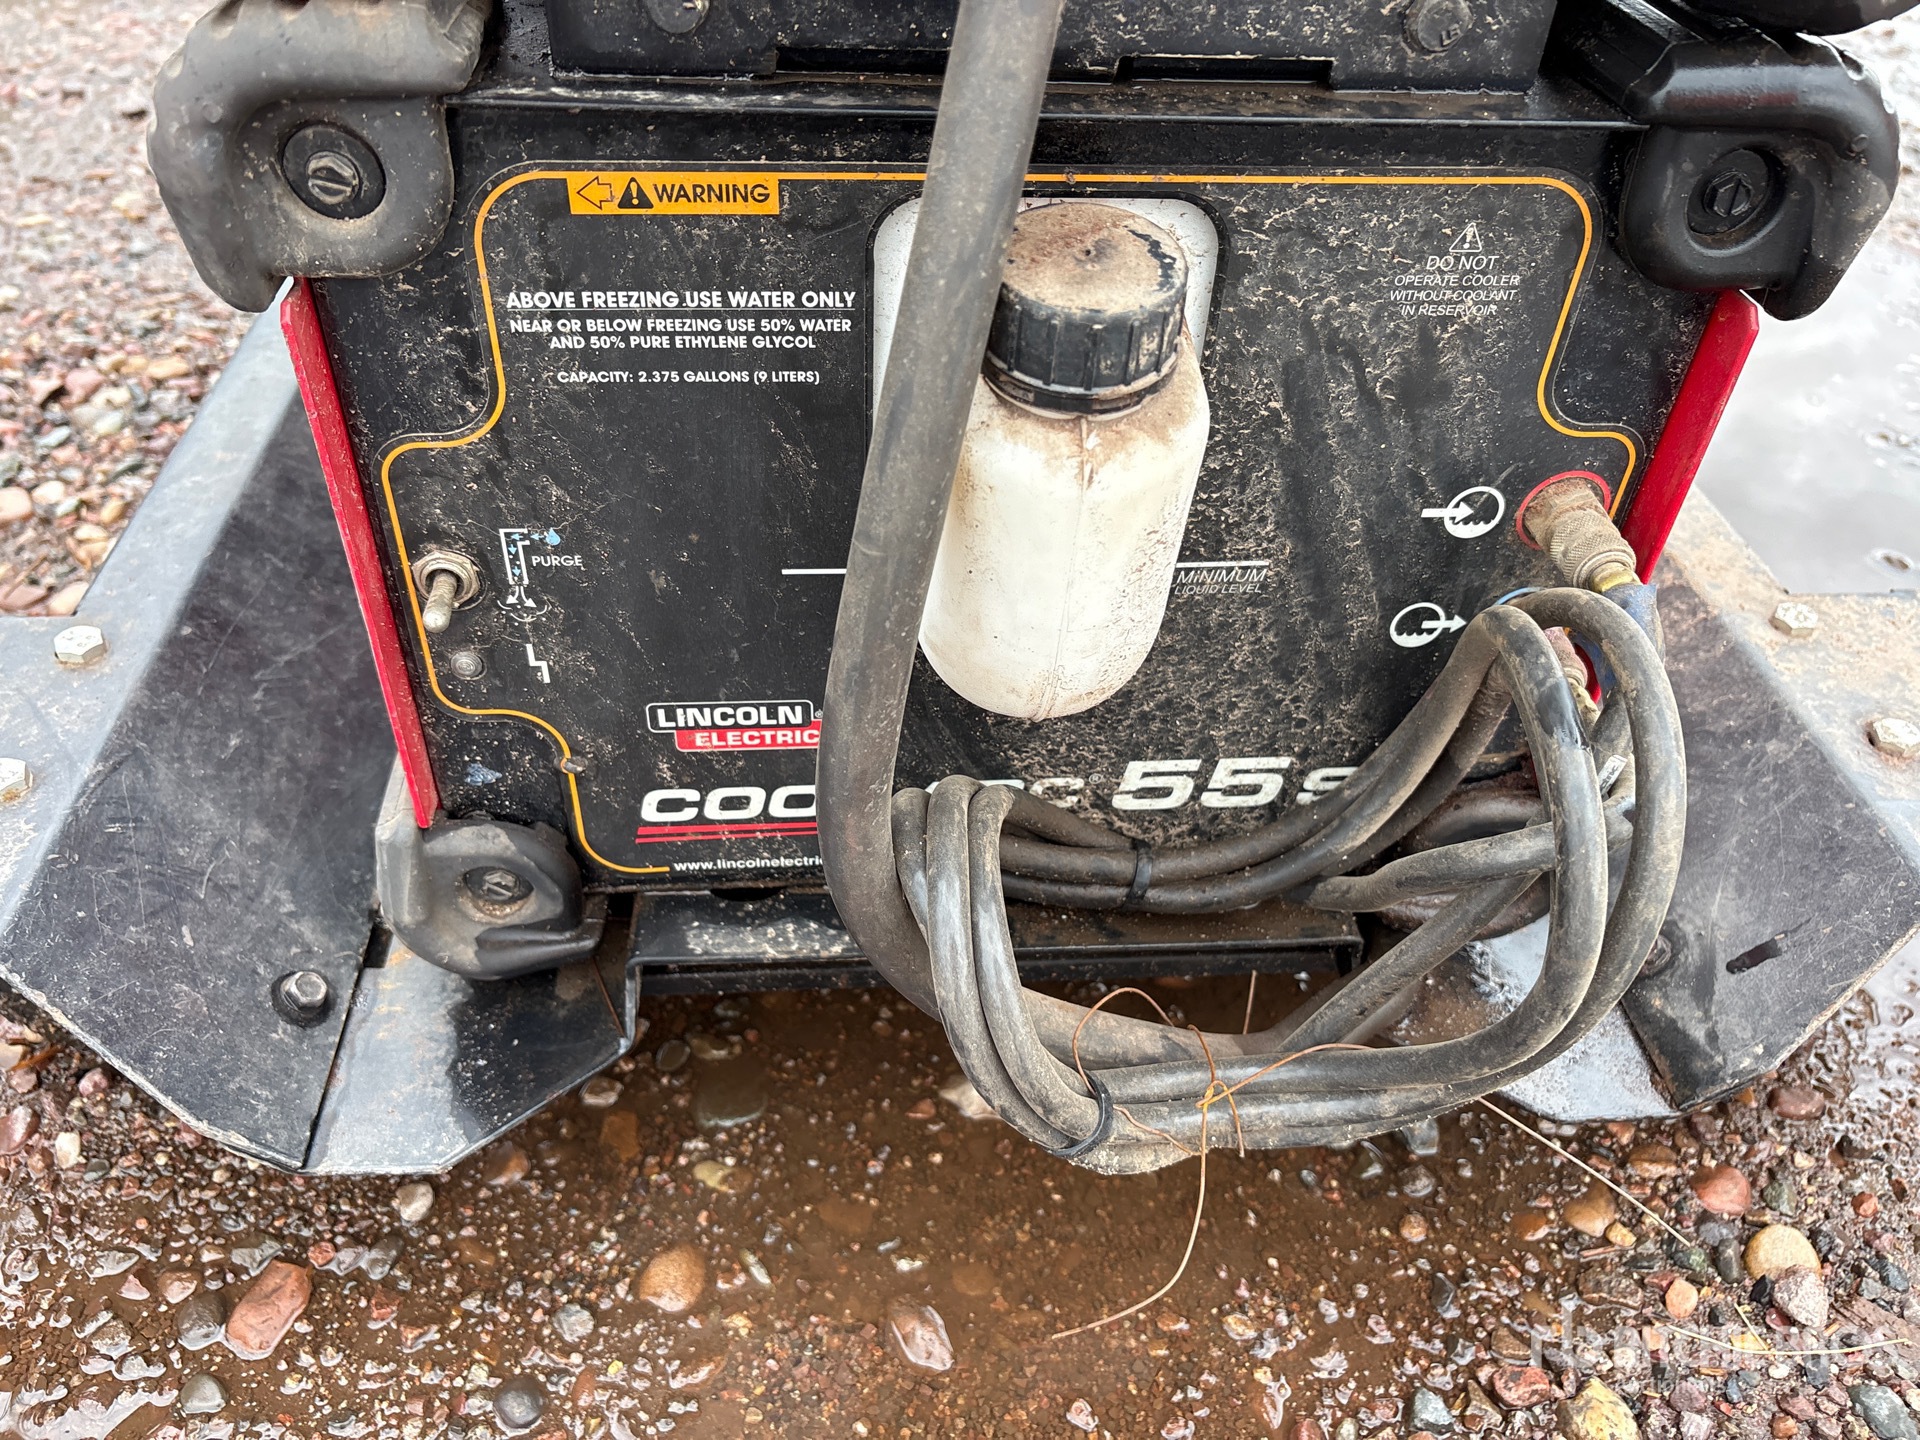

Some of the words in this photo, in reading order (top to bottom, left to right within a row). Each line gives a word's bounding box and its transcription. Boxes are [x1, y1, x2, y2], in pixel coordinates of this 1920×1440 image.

[653, 183, 771, 204] WARNING
[1426, 255, 1455, 270] DO
[1458, 255, 1500, 270] NOT
[1394, 275, 1460, 286] OPERATE
[1462, 275, 1521, 286] COOLER
[506, 291, 575, 308] ABOVE
[581, 290, 678, 308] FREEZING
[728, 291, 795, 308] WATER
[801, 291, 856, 308] ONLY
[1390, 290, 1450, 301] WITHOUT
[1452, 290, 1518, 301] COOLANT
[1400, 305, 1416, 316] IN
[1418, 304, 1498, 316] RESERVOIR
[510, 318, 552, 333] NEAR
[556, 318, 582, 332] OR
[586, 318, 642, 332] BELOW
[647, 318, 722, 332] FREEZING
[727, 318, 756, 332] USE
[760, 318, 796, 332] 50%
[800, 318, 852, 332] WATER
[550, 335, 585, 349] AND
[590, 335, 625, 349] 50%
[630, 335, 671, 348] PURE
[675, 335, 748, 348] ETHYLENE
[752, 335, 816, 349] GLYCOL
[557, 370, 634, 384] CAPACITY:
[638, 370, 680, 383] 2.375
[683, 370, 750, 383] GALLONS
[753, 370, 770, 386] (9
[772, 370, 820, 385] LITERS)
[531, 555, 583, 567] PURGE
[1176, 568, 1268, 583] MINIMUM
[1174, 584, 1219, 595] LIQUID
[1221, 583, 1262, 593] LEVEL
[657, 705, 802, 727] LINCOLN
[695, 729, 820, 746] ELECTRIC
[641, 784, 817, 822] COO
